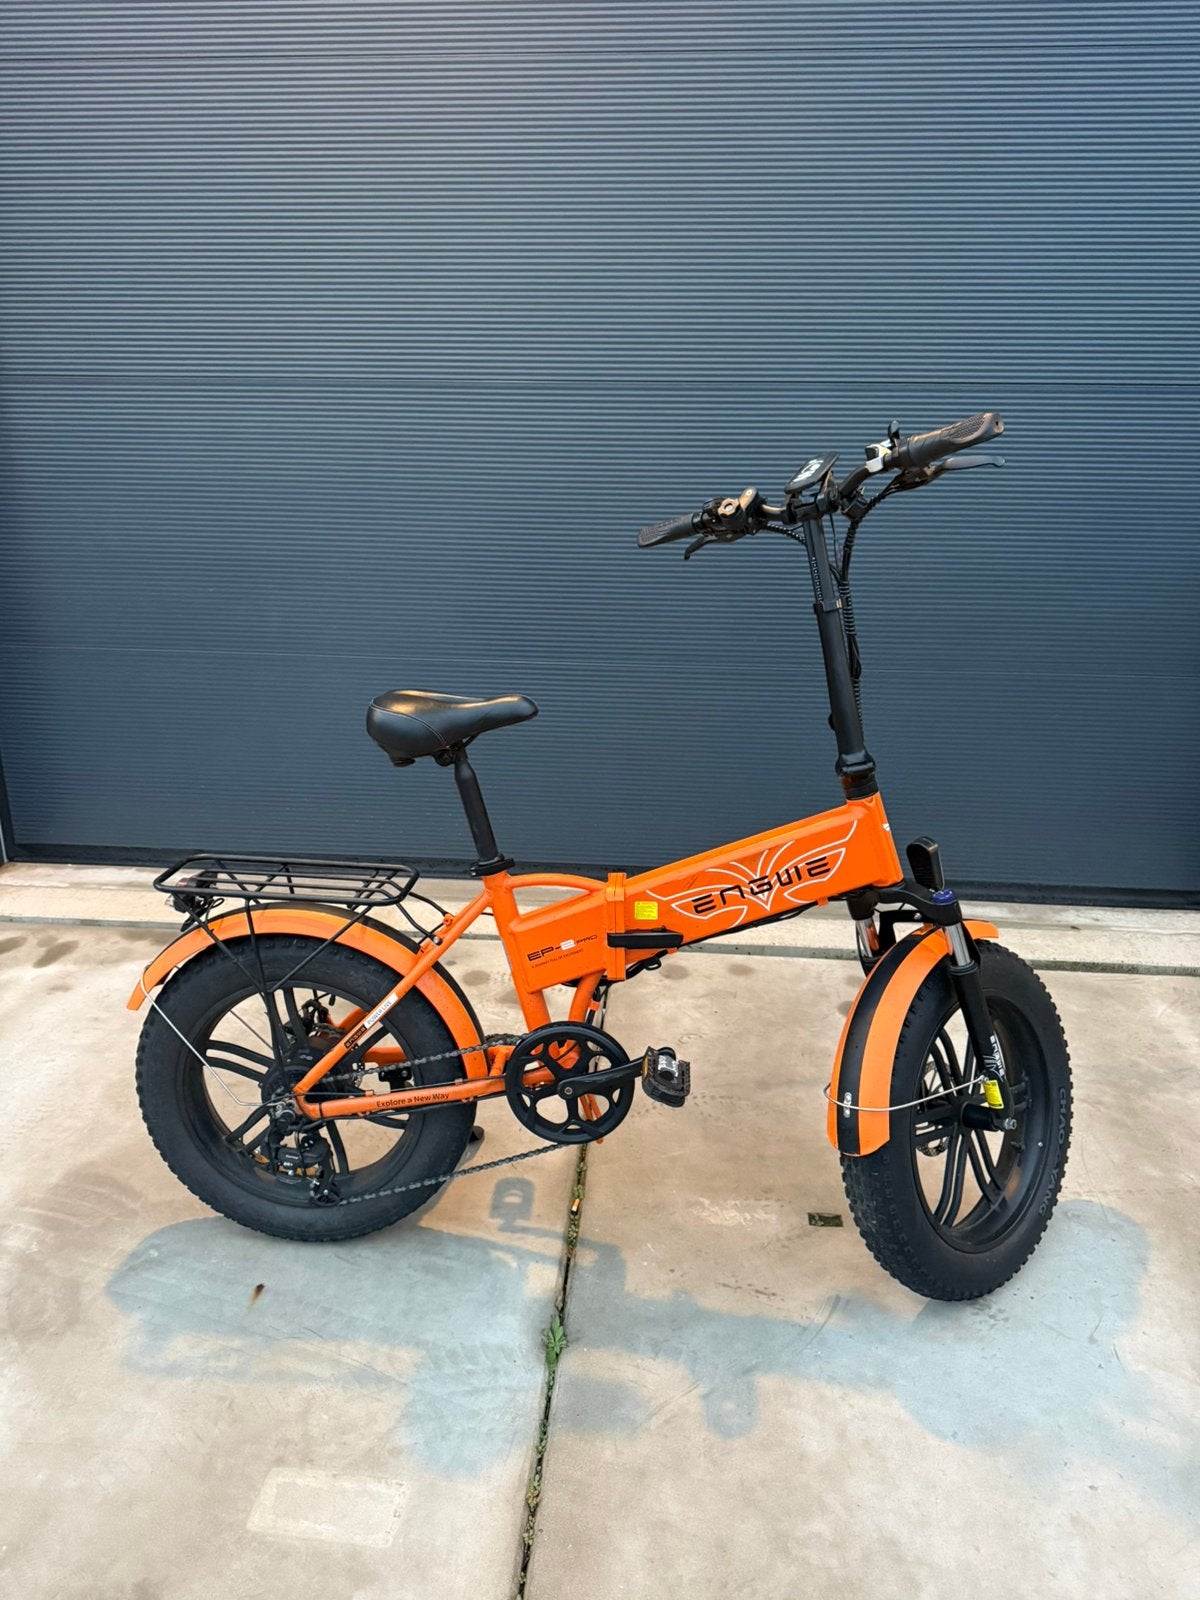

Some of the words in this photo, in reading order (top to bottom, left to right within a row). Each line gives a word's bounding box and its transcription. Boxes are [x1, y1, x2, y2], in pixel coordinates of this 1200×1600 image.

[691, 856, 831, 915] ENGWE
[376, 1099, 406, 1108] Explore
[432, 1092, 450, 1100] Way
